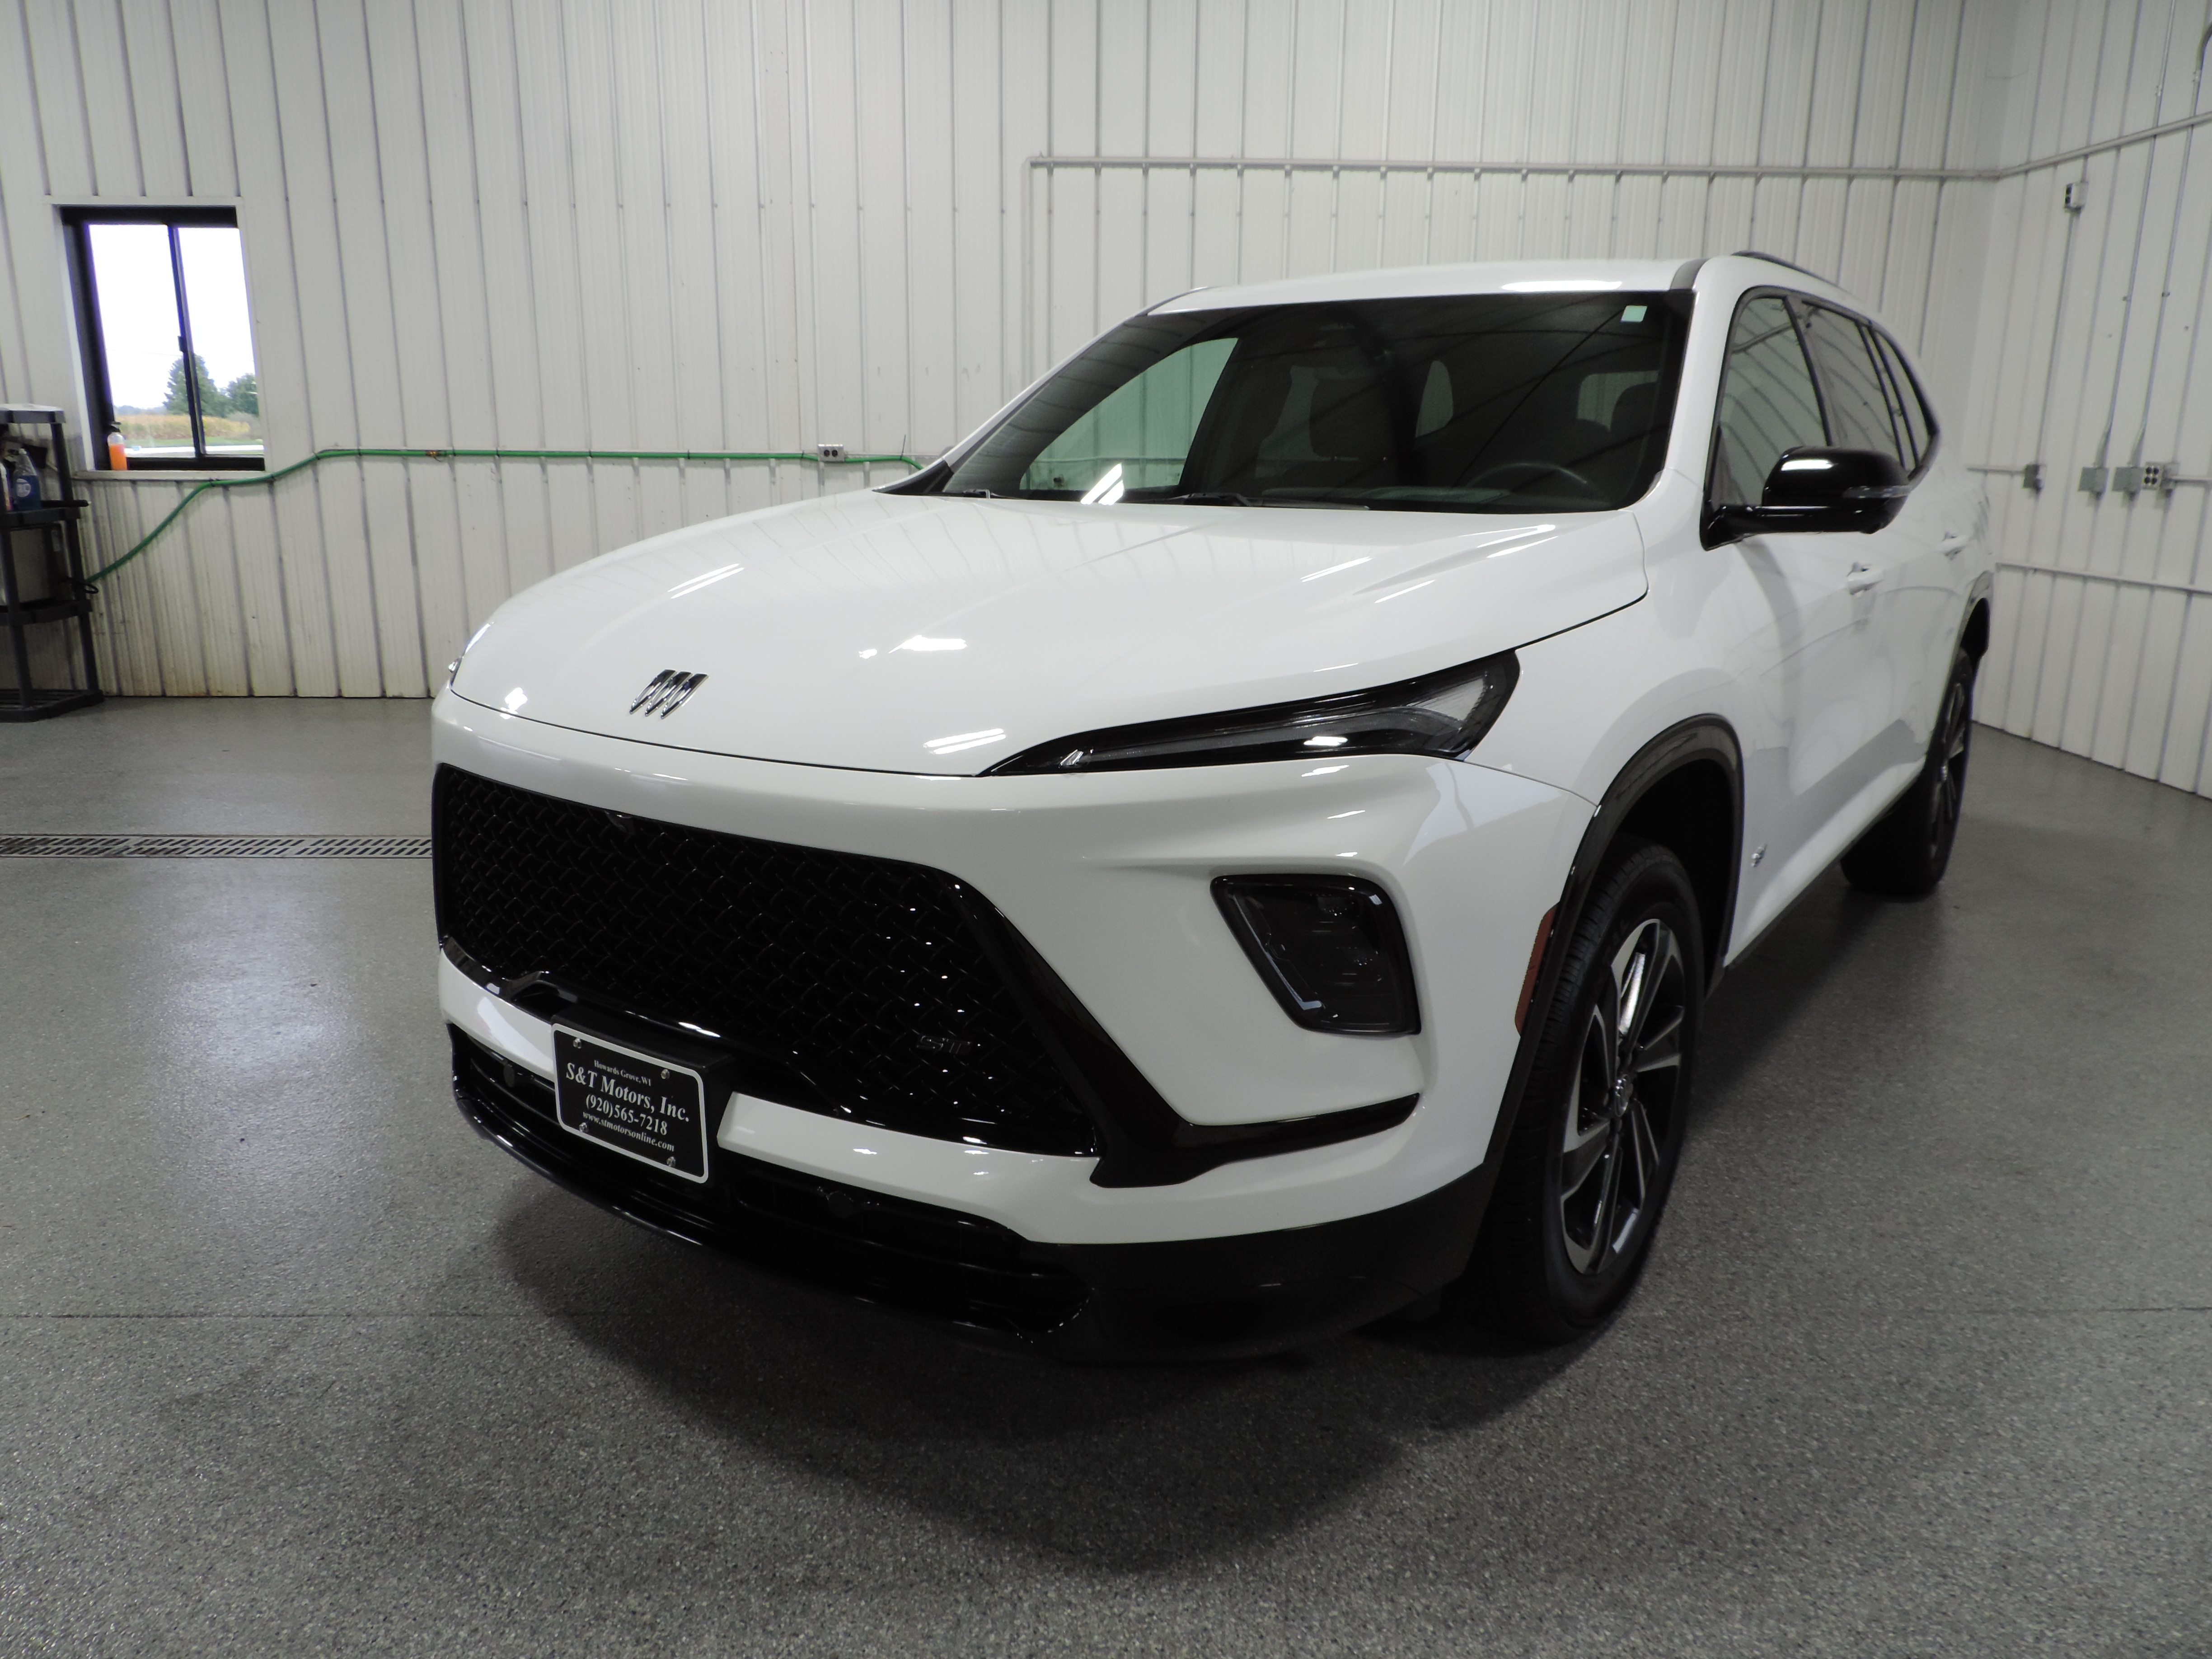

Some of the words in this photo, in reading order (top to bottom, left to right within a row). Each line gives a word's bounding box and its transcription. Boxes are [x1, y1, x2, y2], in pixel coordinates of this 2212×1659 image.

[594, 1059, 619, 1075] Howards
[566, 1062, 597, 1087] S&T
[600, 1079, 655, 1113] Motors,
[660, 1096, 689, 1122] Inc.
[583, 1111, 675, 1151] www.stmotorsonline.com
[586, 1094, 668, 1135] (920)565-7218
